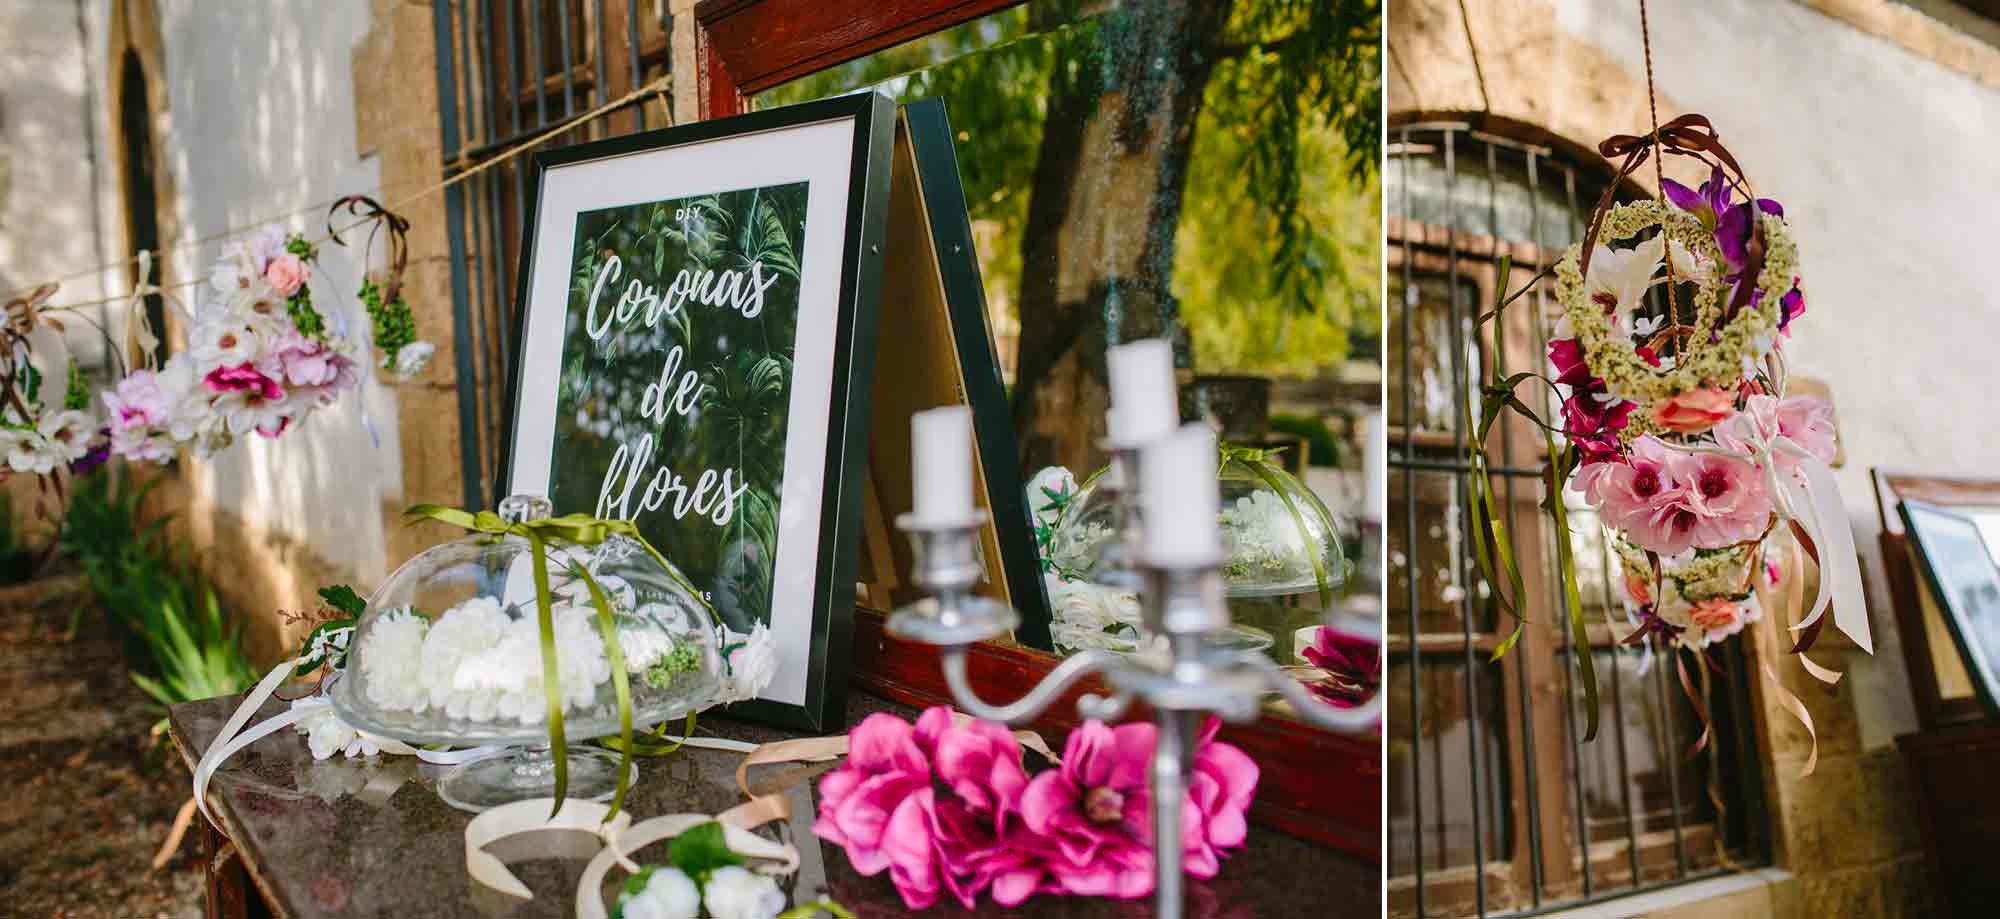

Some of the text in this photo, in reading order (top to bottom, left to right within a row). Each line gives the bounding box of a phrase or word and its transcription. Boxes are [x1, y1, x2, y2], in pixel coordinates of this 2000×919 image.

[675, 205, 702, 220] DIY
[585, 255, 779, 340] Coronas
[640, 346, 705, 424] de
[595, 433, 749, 525] flores
